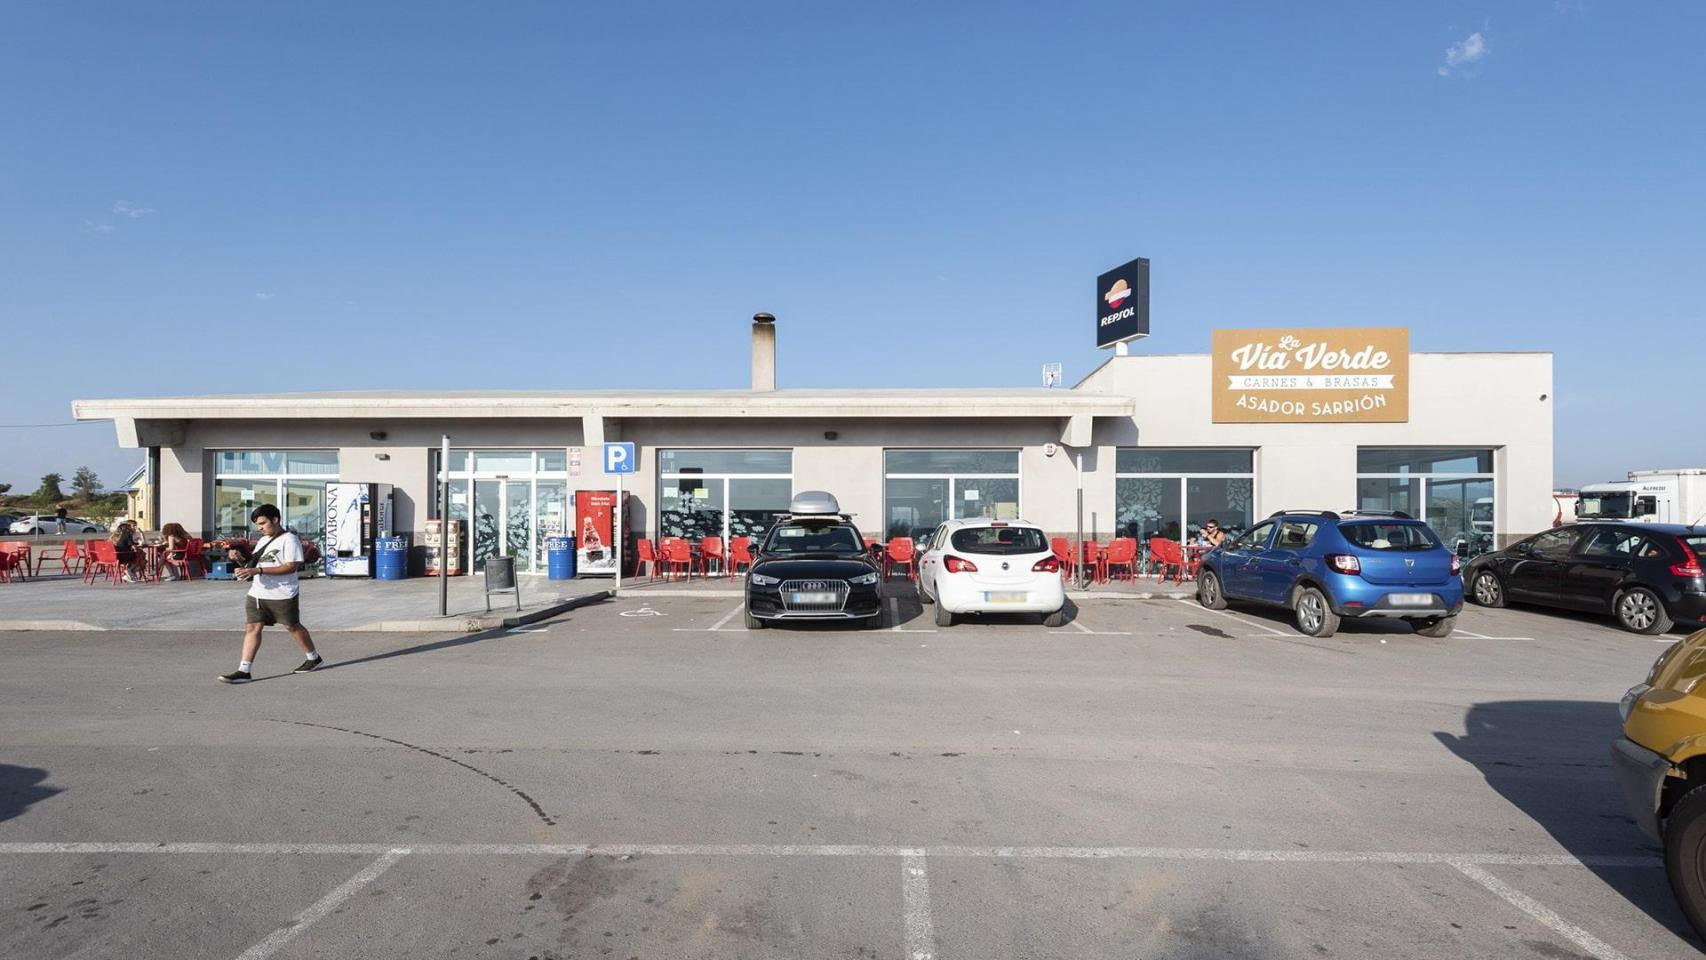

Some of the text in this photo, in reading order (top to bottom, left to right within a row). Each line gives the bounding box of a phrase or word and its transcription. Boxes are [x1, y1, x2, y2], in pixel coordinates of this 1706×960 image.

[1101, 307, 1135, 327] REPSOL
[1278, 335, 1301, 350] La
[1231, 343, 1391, 370] Vía Verde
[1243, 377, 1379, 387] CARNES & BRASAS
[1236, 393, 1387, 416] ASADOR SARRIÓN
[608, 446, 627, 471] P
[327, 487, 338, 568] AQUABONA
